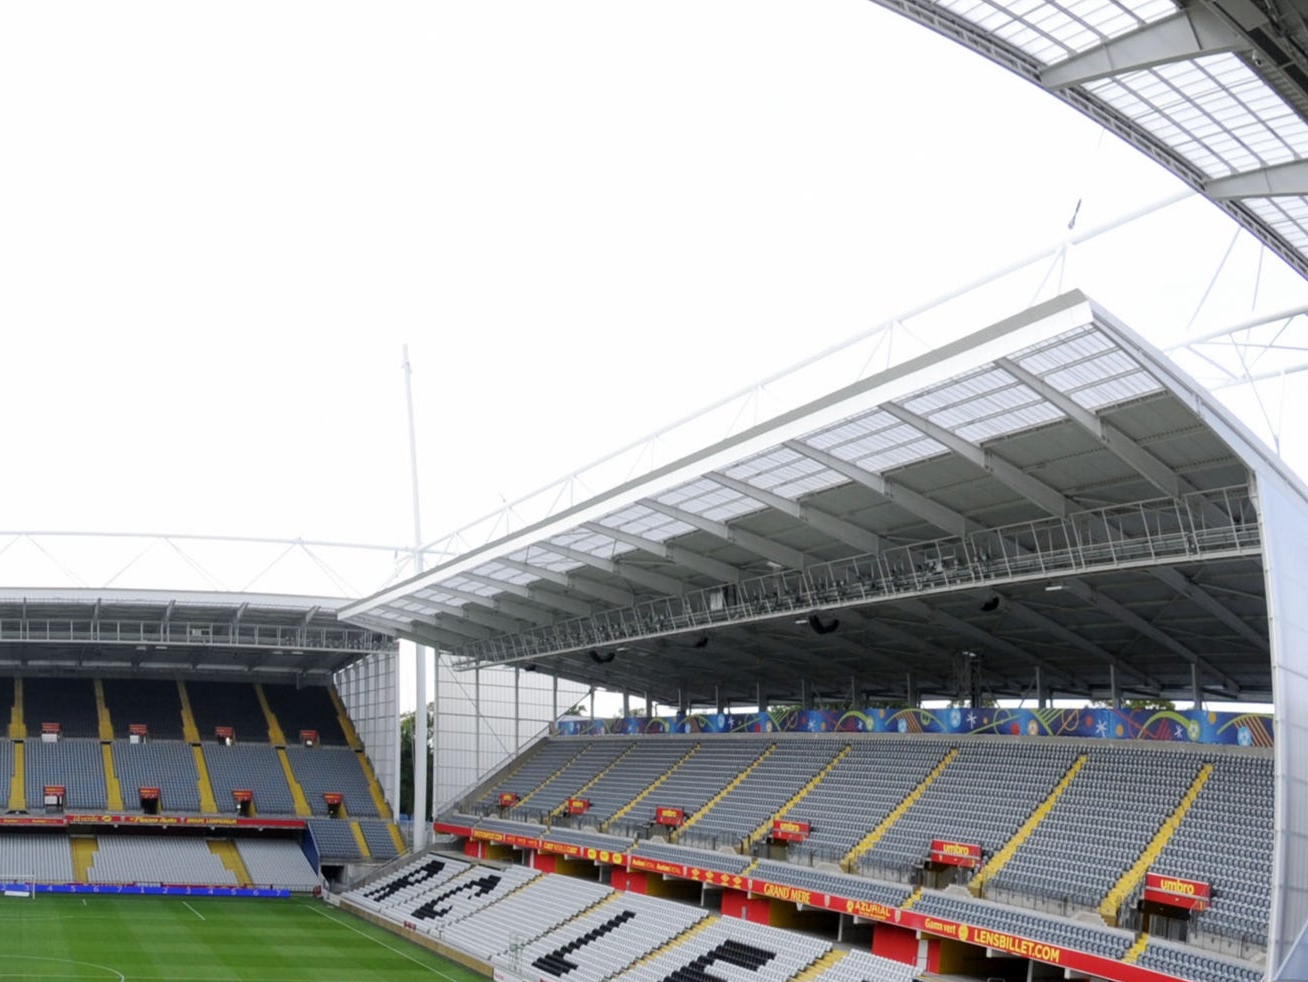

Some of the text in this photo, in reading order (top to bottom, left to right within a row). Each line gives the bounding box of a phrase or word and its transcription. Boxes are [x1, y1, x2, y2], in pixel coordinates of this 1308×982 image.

[943, 842, 969, 856] umbro
[1160, 878, 1194, 895] umbro
[855, 901, 890, 917] AZURIAL
[944, 923, 956, 935] vert
[974, 929, 1060, 963] LENSBILLET.COM
